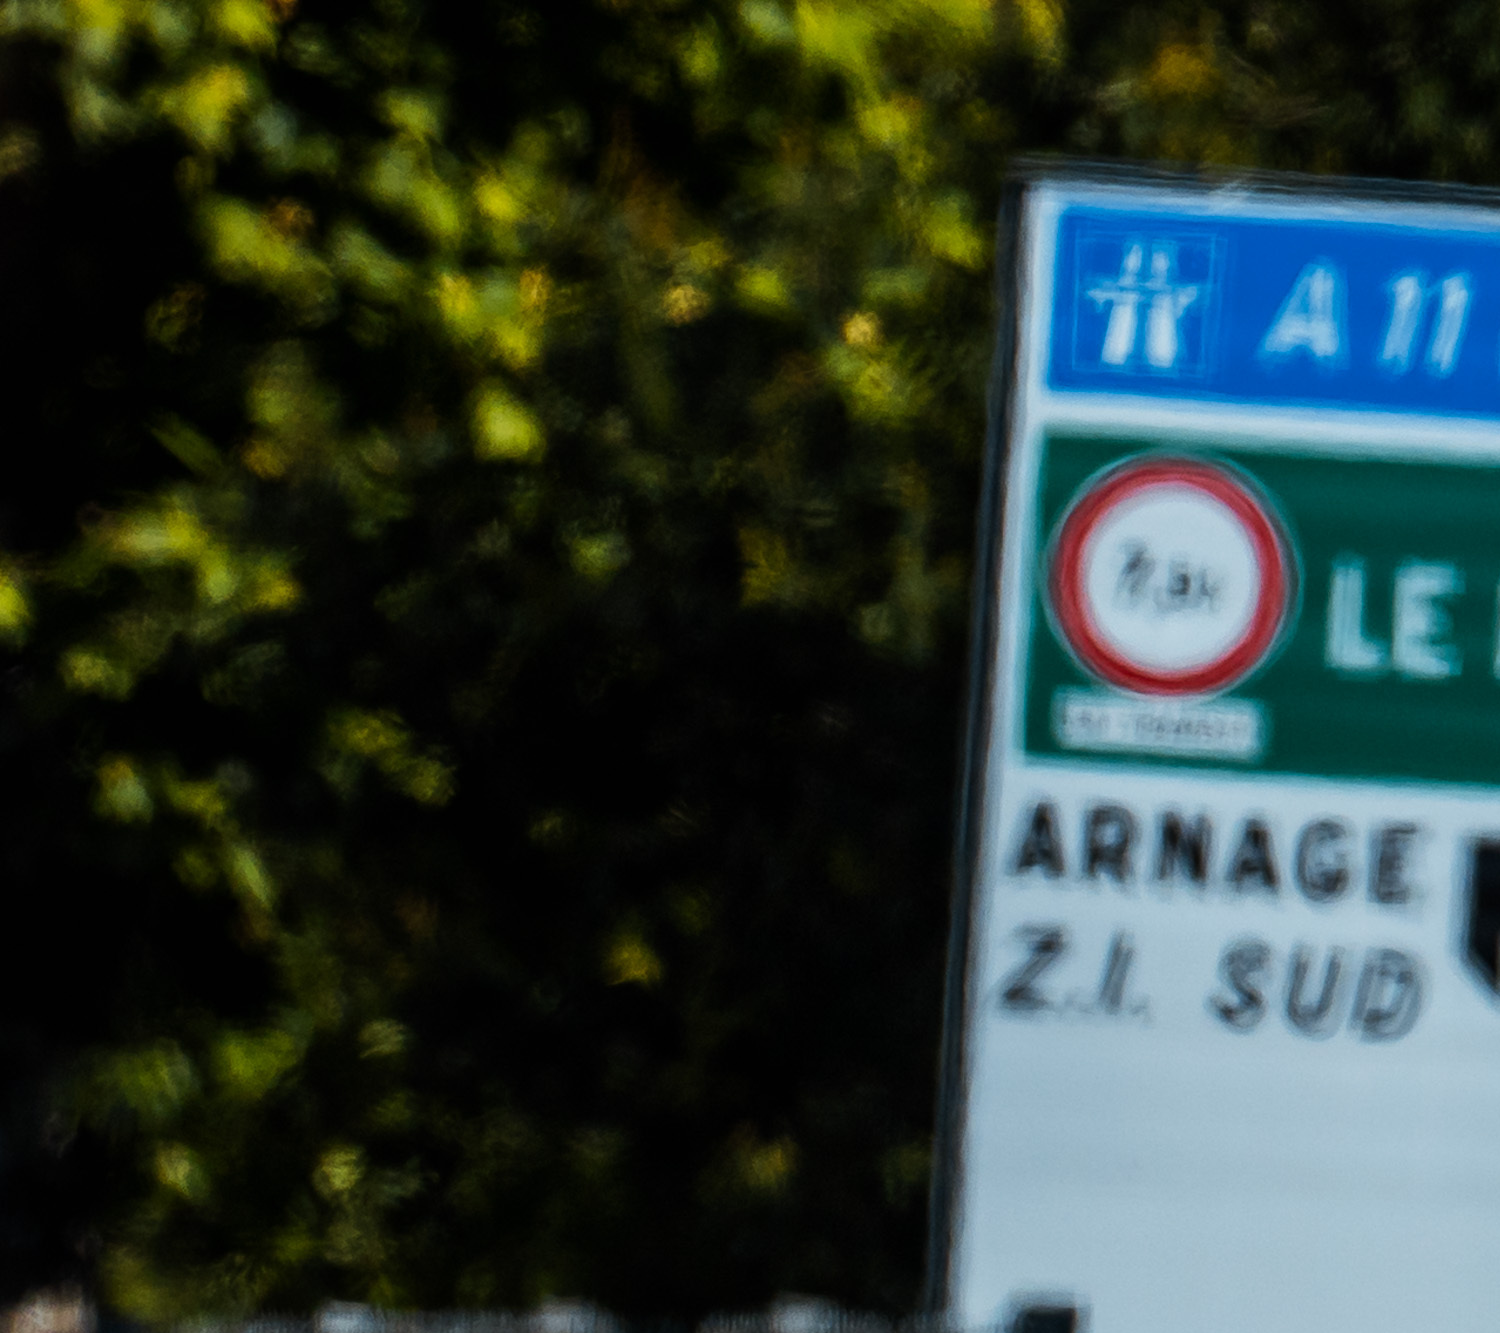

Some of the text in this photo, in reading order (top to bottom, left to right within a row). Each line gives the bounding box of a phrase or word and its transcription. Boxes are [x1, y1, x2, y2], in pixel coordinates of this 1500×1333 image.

[1256, 257, 1346, 362] A
[1380, 272, 1474, 376] 11
[1324, 554, 1466, 680] LE
[1003, 798, 1439, 908] ARNAGE
[1212, 937, 1430, 1043] SUD
